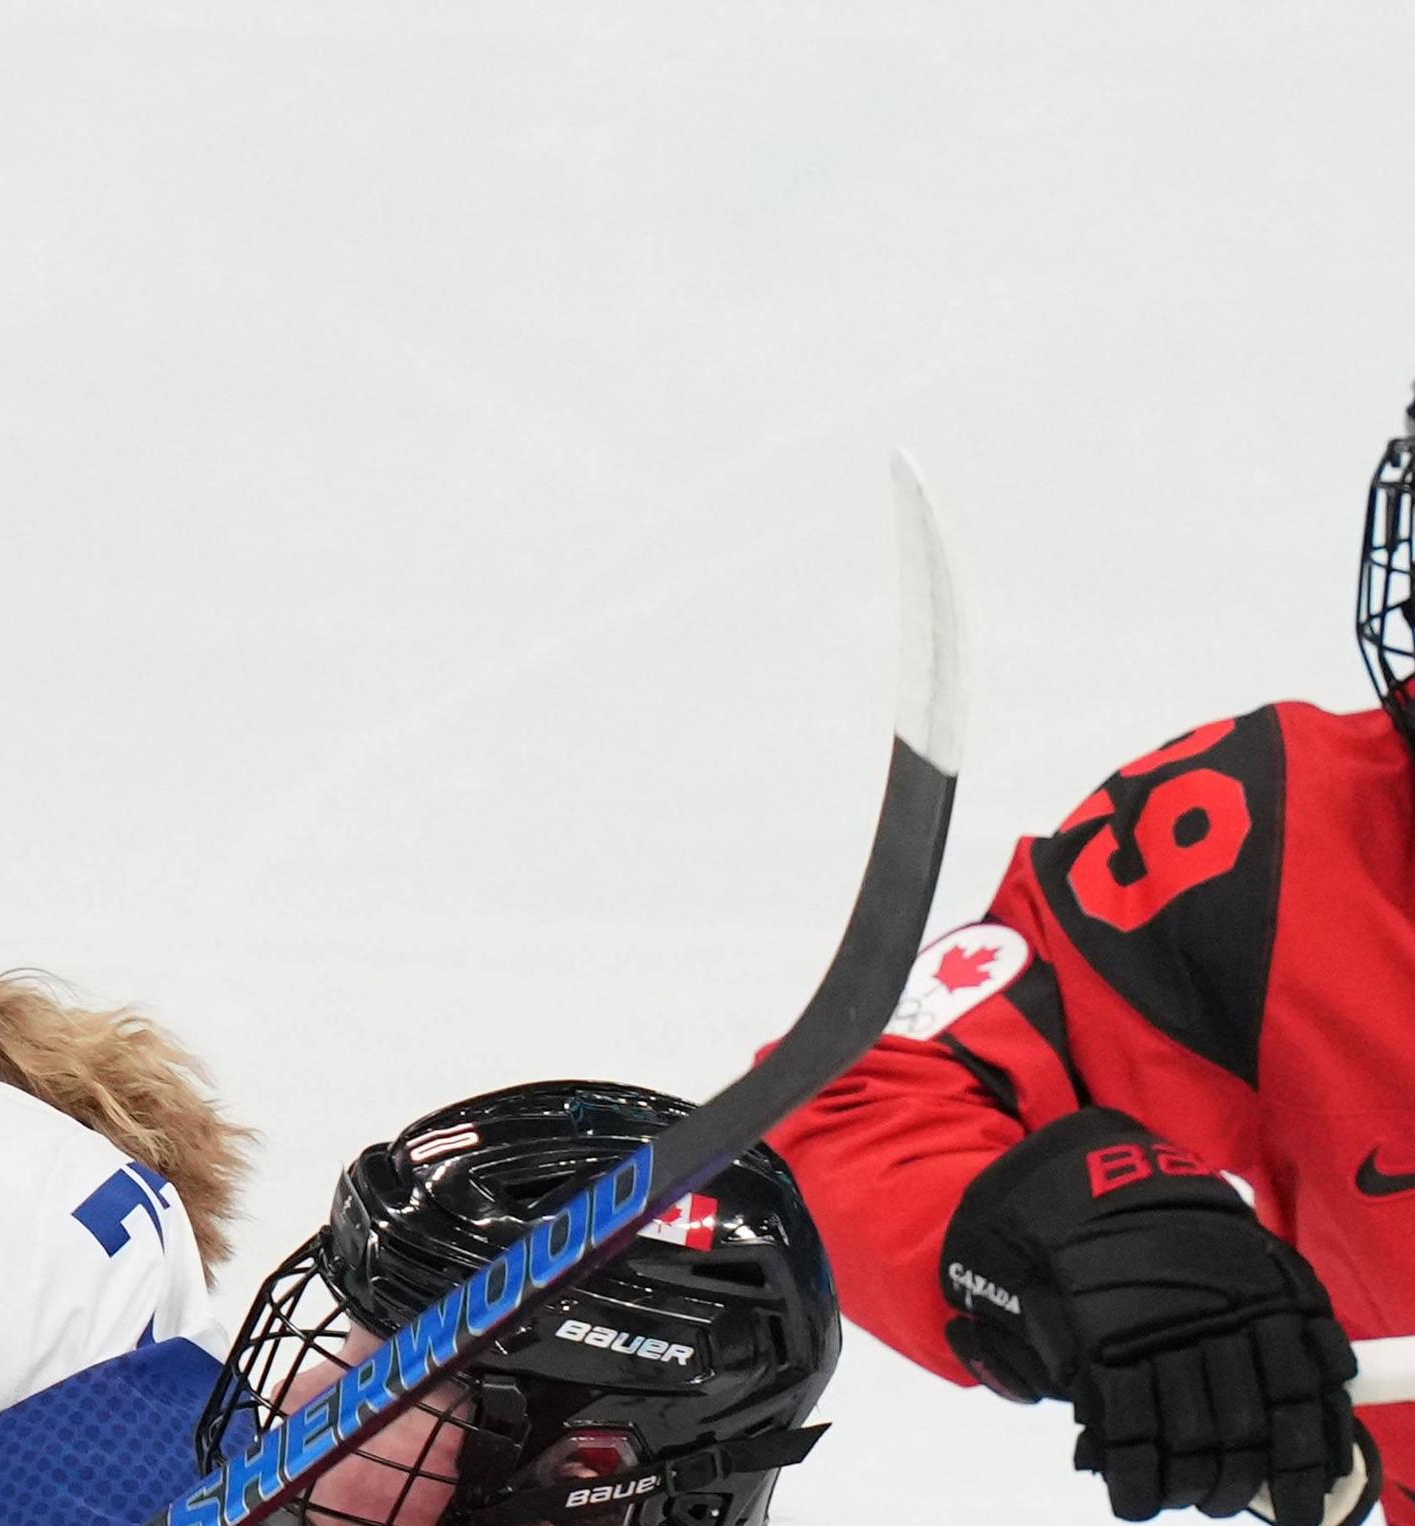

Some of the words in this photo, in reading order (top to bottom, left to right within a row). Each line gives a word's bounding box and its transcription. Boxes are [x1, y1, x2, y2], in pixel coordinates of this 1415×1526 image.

[1059, 717, 1252, 933] 9
[948, 1262, 1022, 1315] CANADA
[554, 1318, 696, 1367] BAUER
